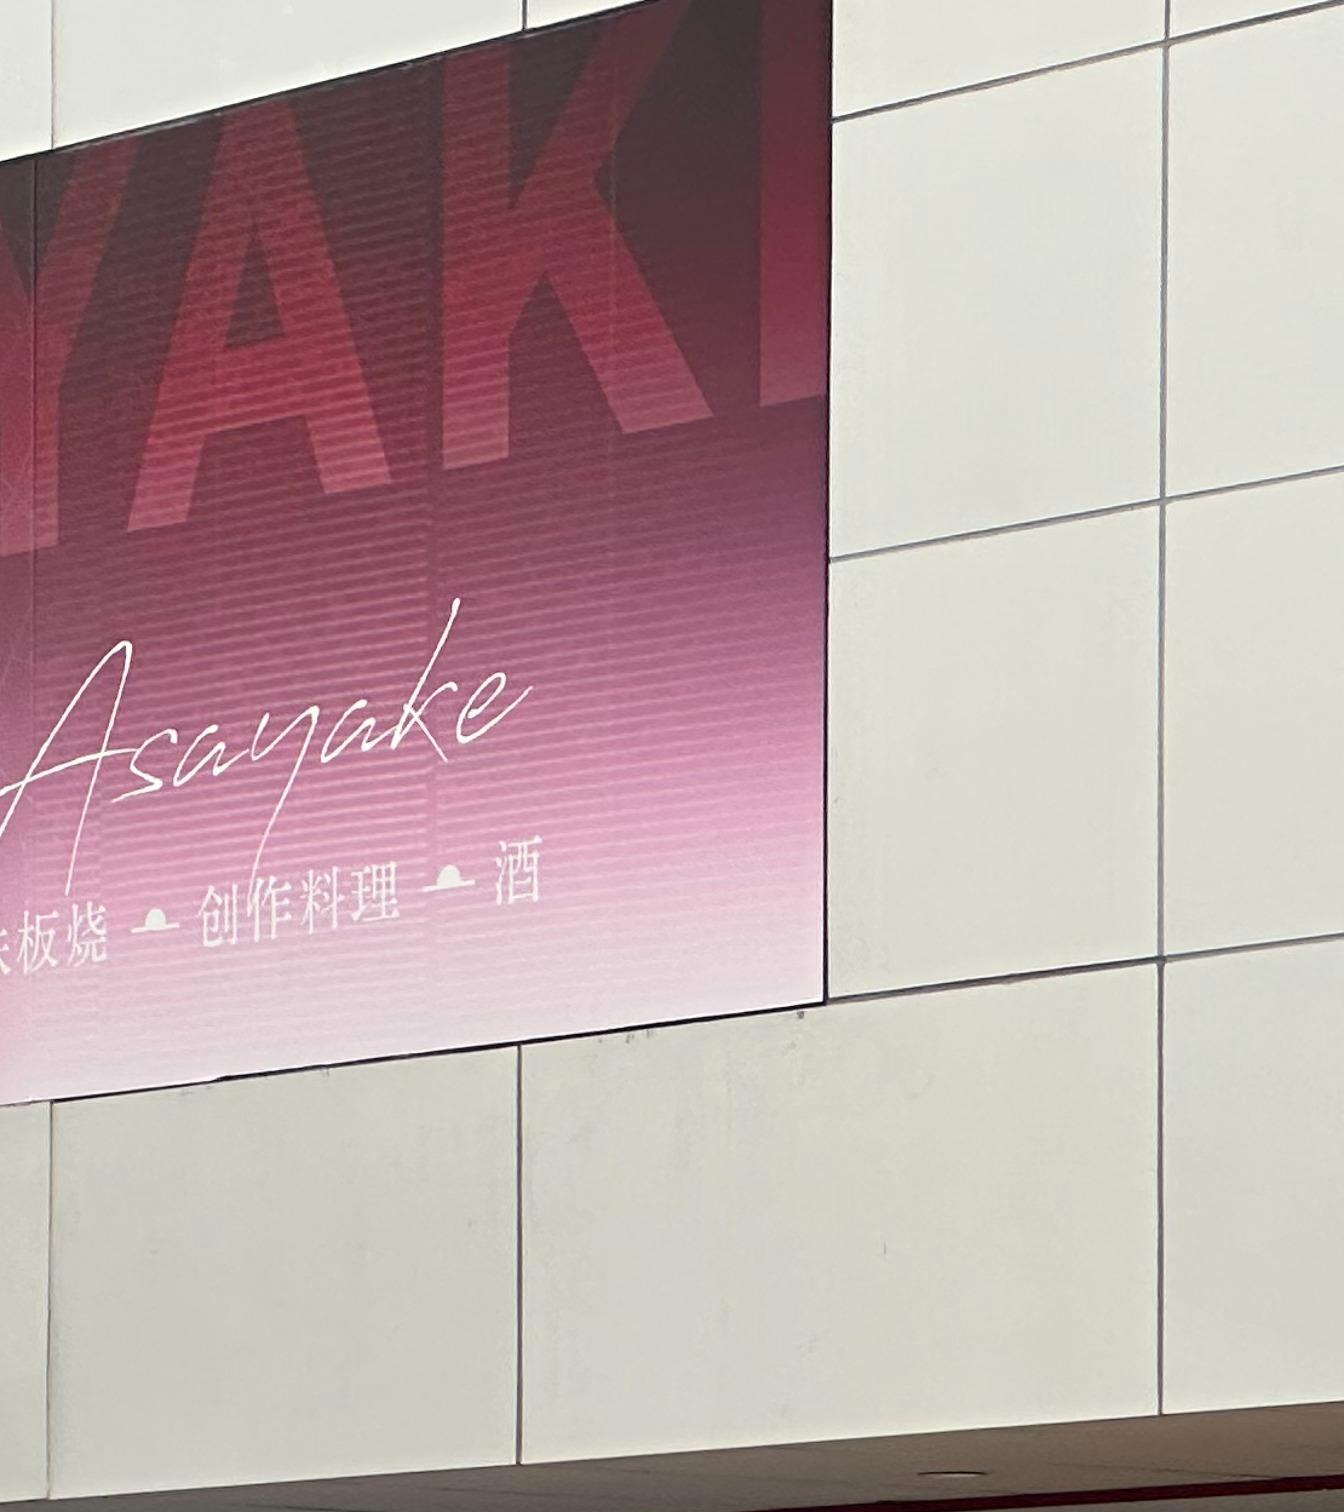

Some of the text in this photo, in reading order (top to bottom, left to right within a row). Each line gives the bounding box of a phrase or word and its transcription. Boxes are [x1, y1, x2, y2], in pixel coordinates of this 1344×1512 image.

[198, 861, 402, 950] 创作料理
[493, 835, 543, 906] 酒
